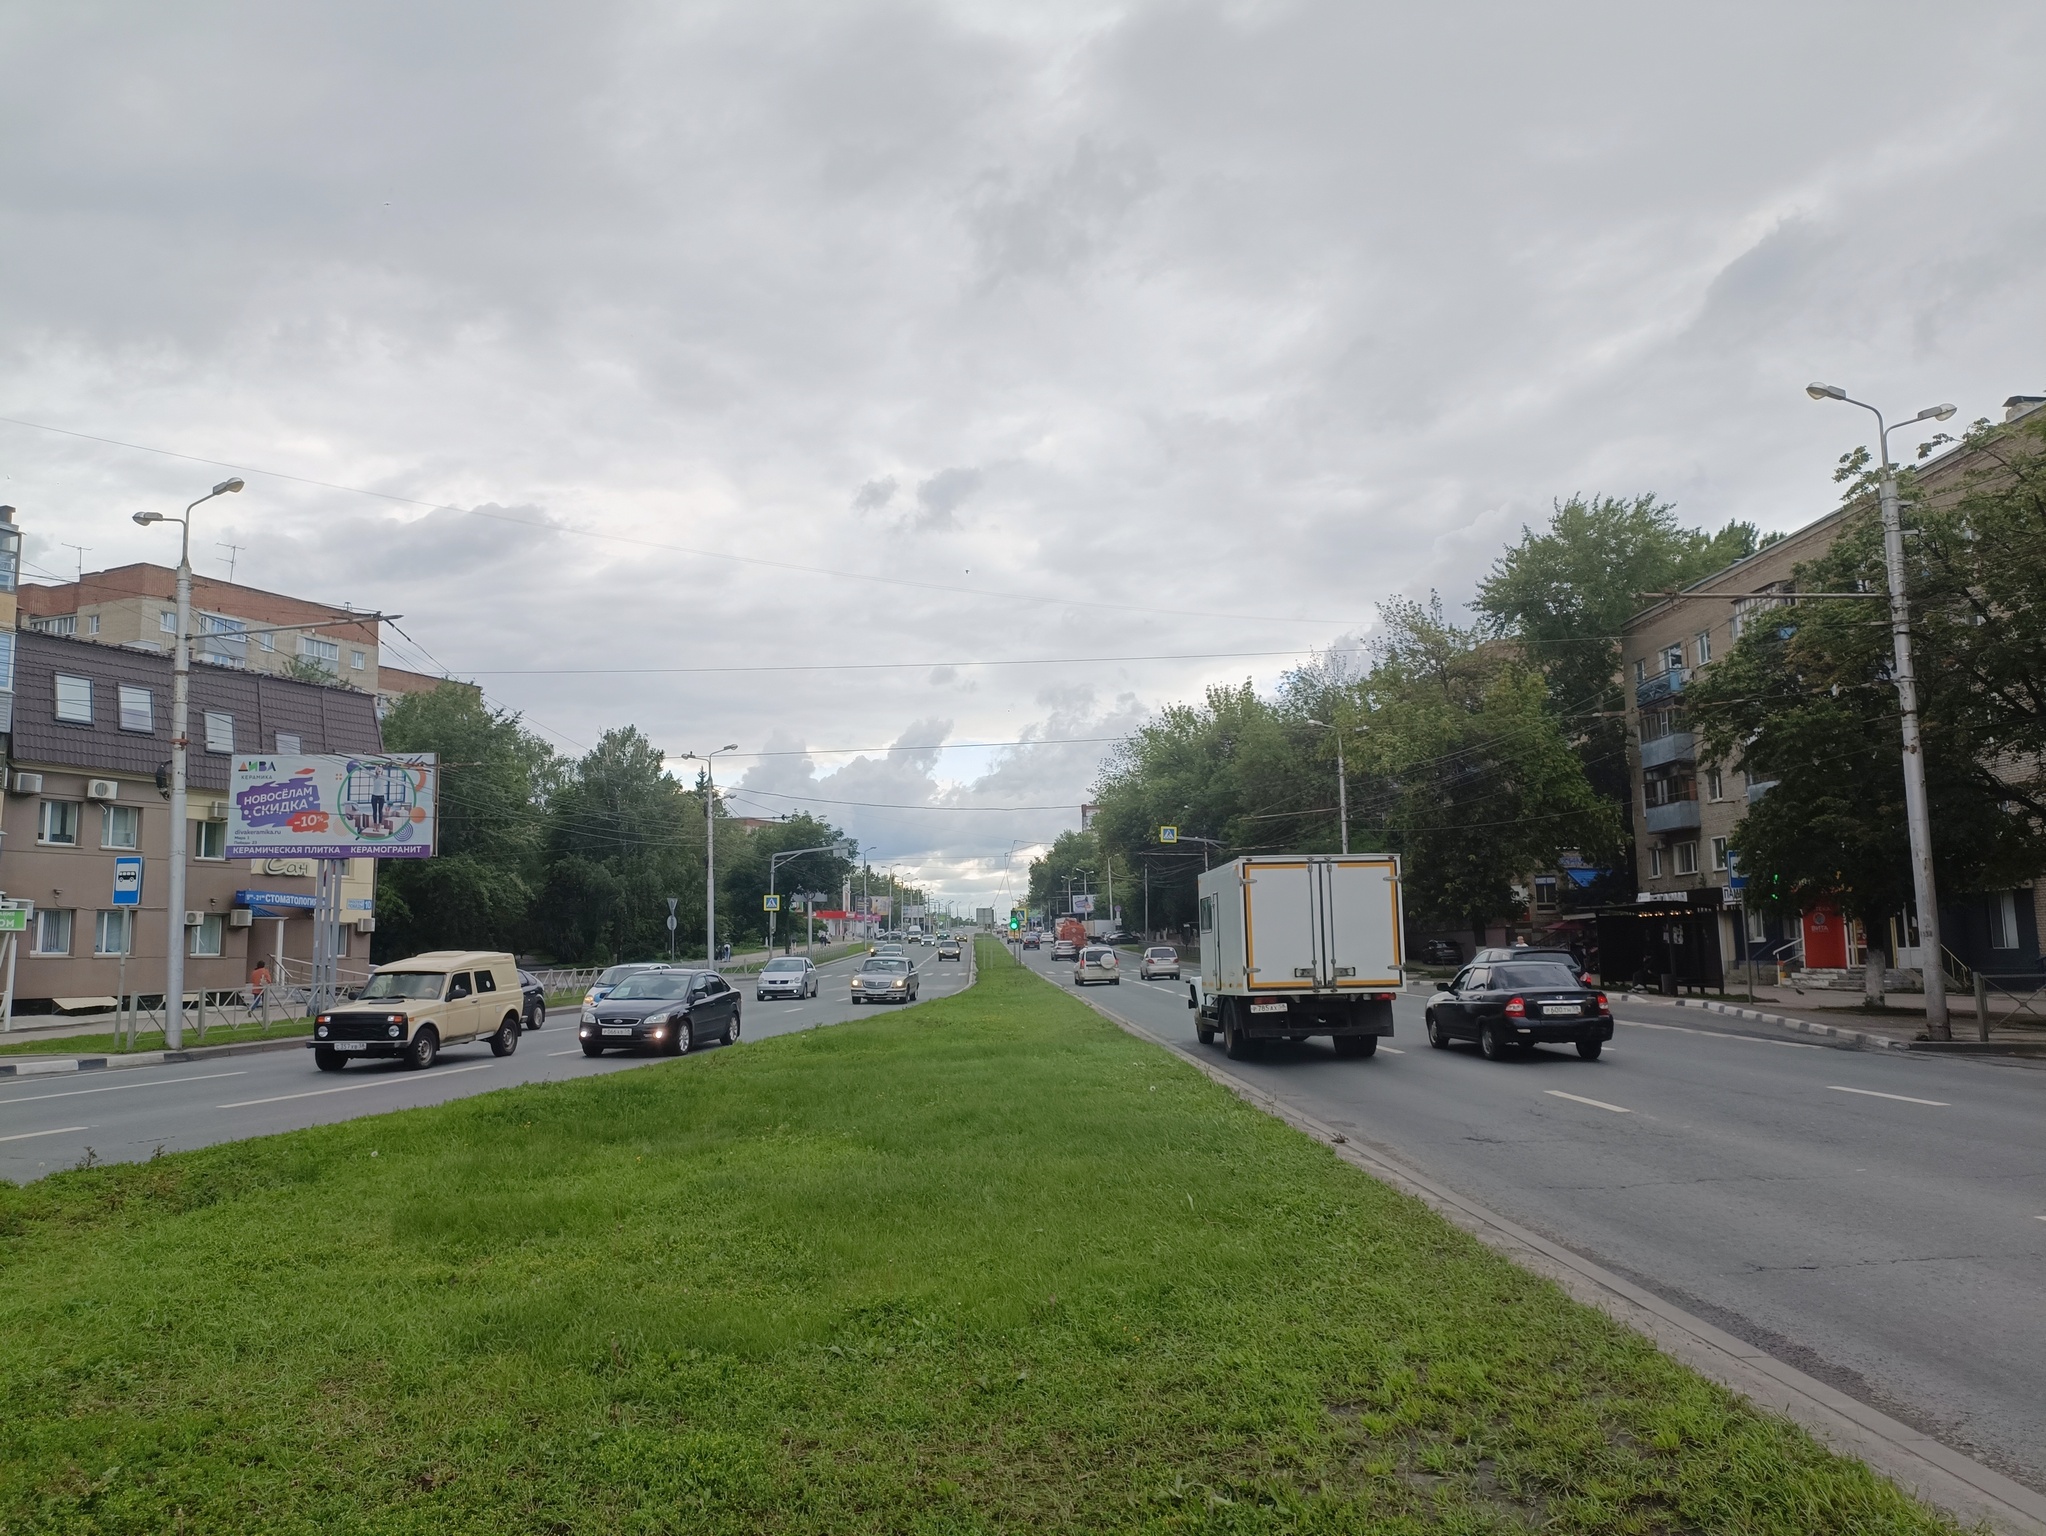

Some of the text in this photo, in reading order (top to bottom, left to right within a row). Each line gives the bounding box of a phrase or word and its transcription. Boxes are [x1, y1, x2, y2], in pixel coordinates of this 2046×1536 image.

[238, 761, 276, 772] ДИВА
[244, 786, 313, 806] НОВОСЁЛАМ
[253, 799, 308, 817] СКИДКА
[350, 846, 422, 854] КЕРАМОГРАНИТ
[364, 900, 372, 909] 10
